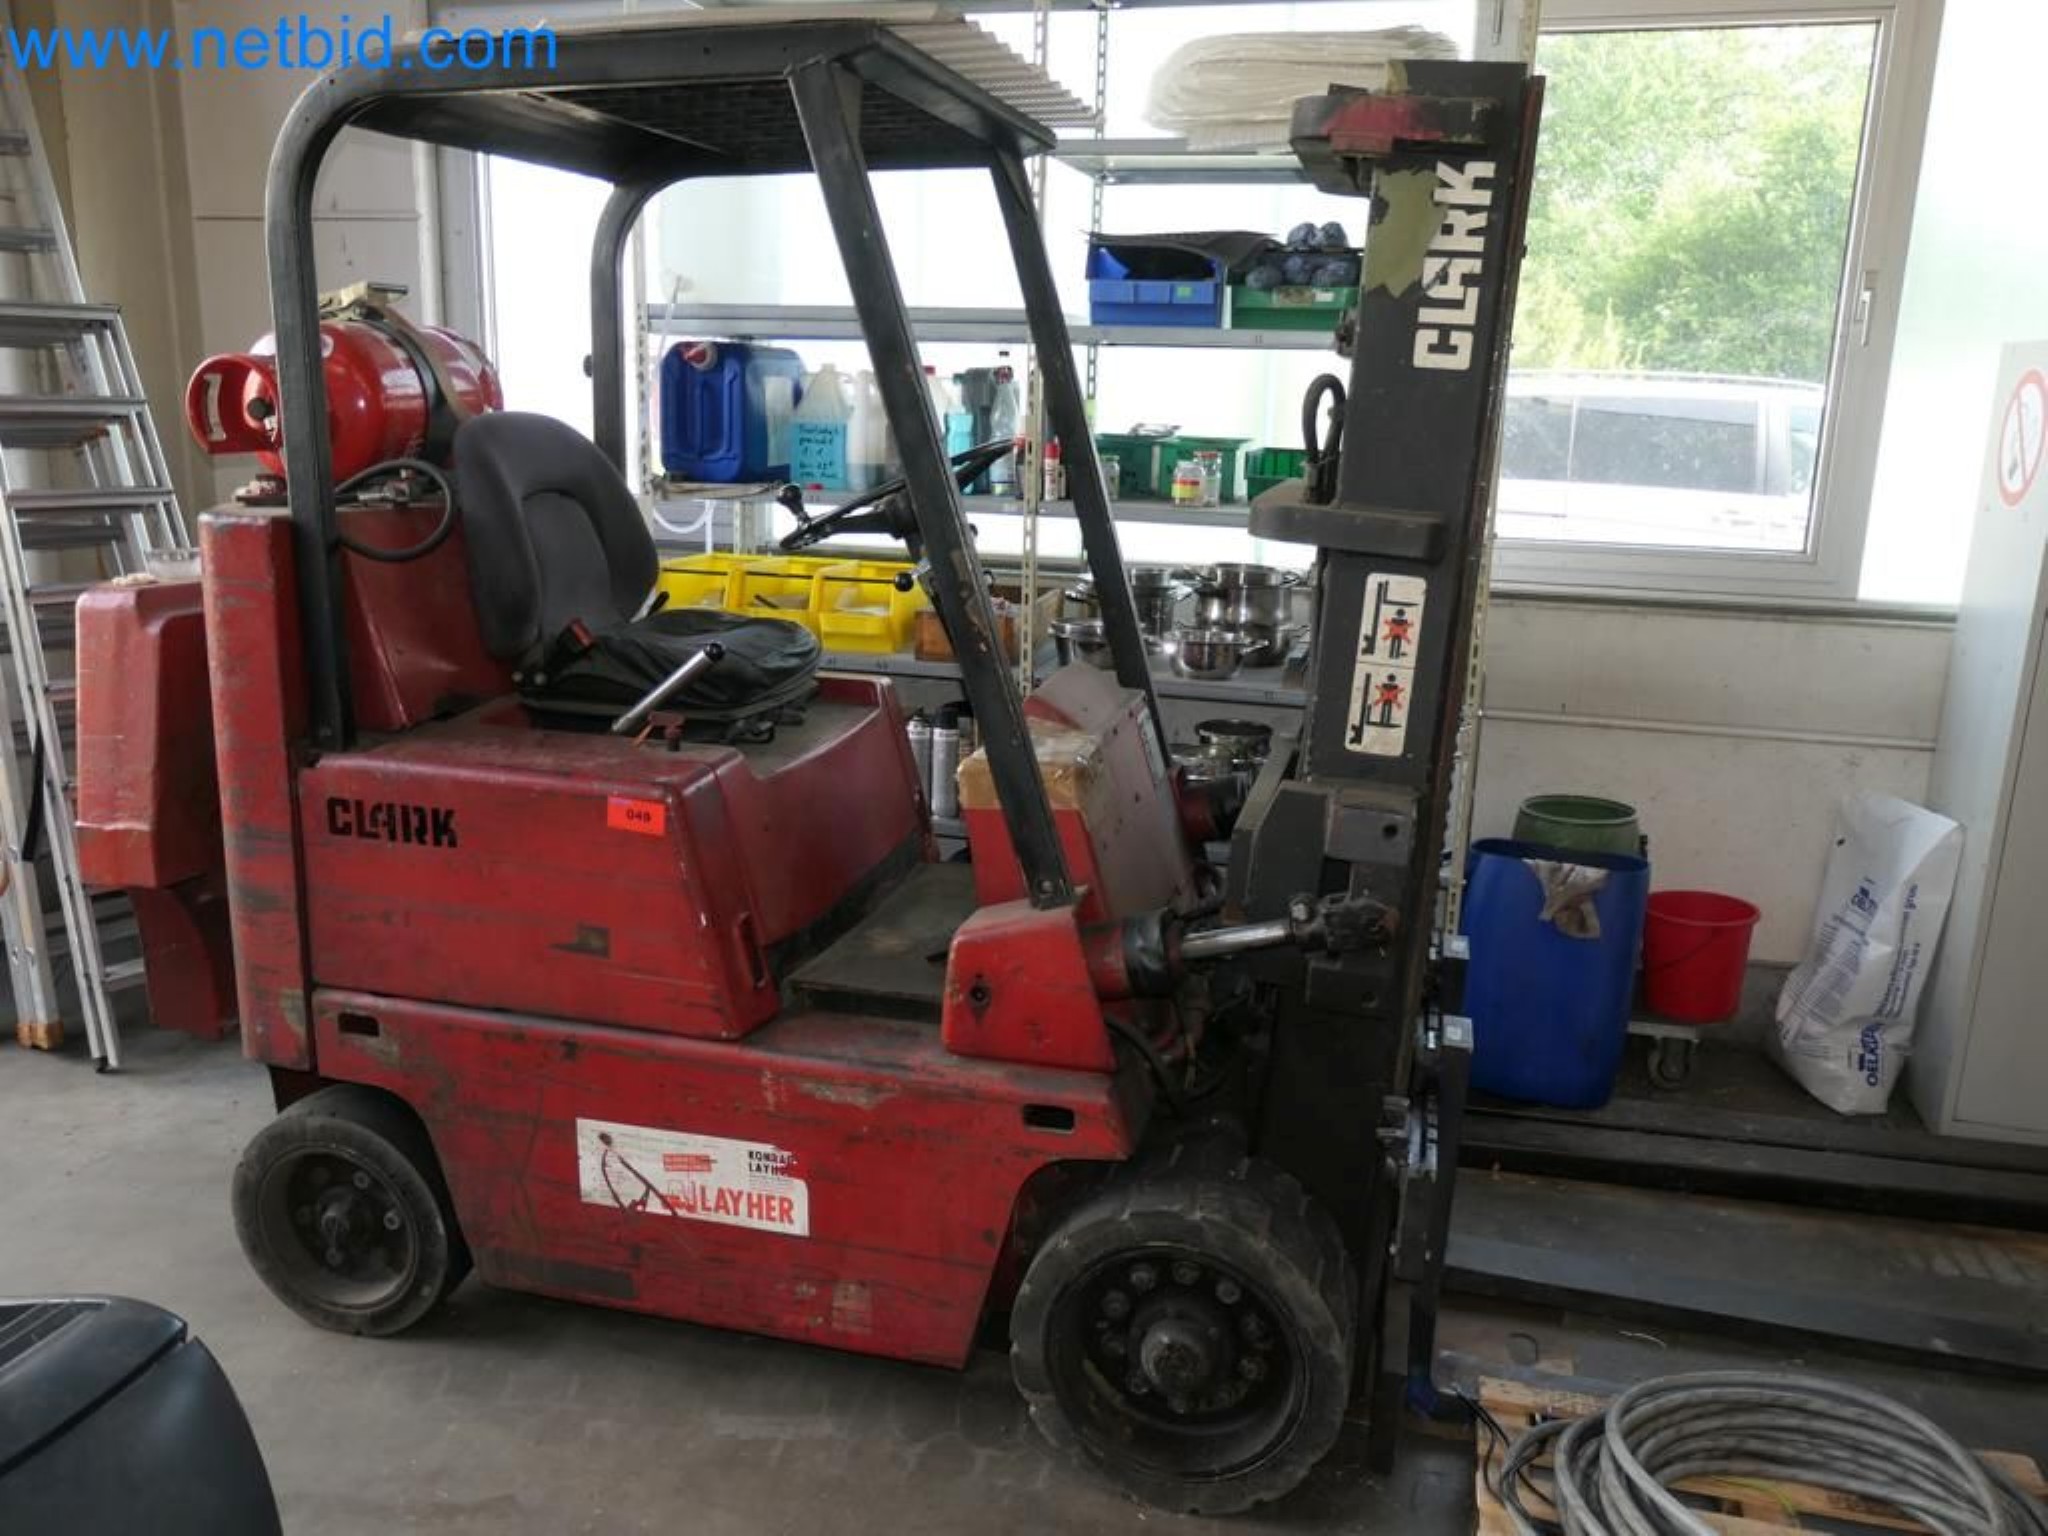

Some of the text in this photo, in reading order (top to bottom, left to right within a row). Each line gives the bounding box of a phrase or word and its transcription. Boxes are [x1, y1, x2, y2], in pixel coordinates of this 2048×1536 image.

[1412, 160, 1497, 371] CLARK
[327, 796, 458, 848] CLARK
[700, 1183, 795, 1225] LAYHER
